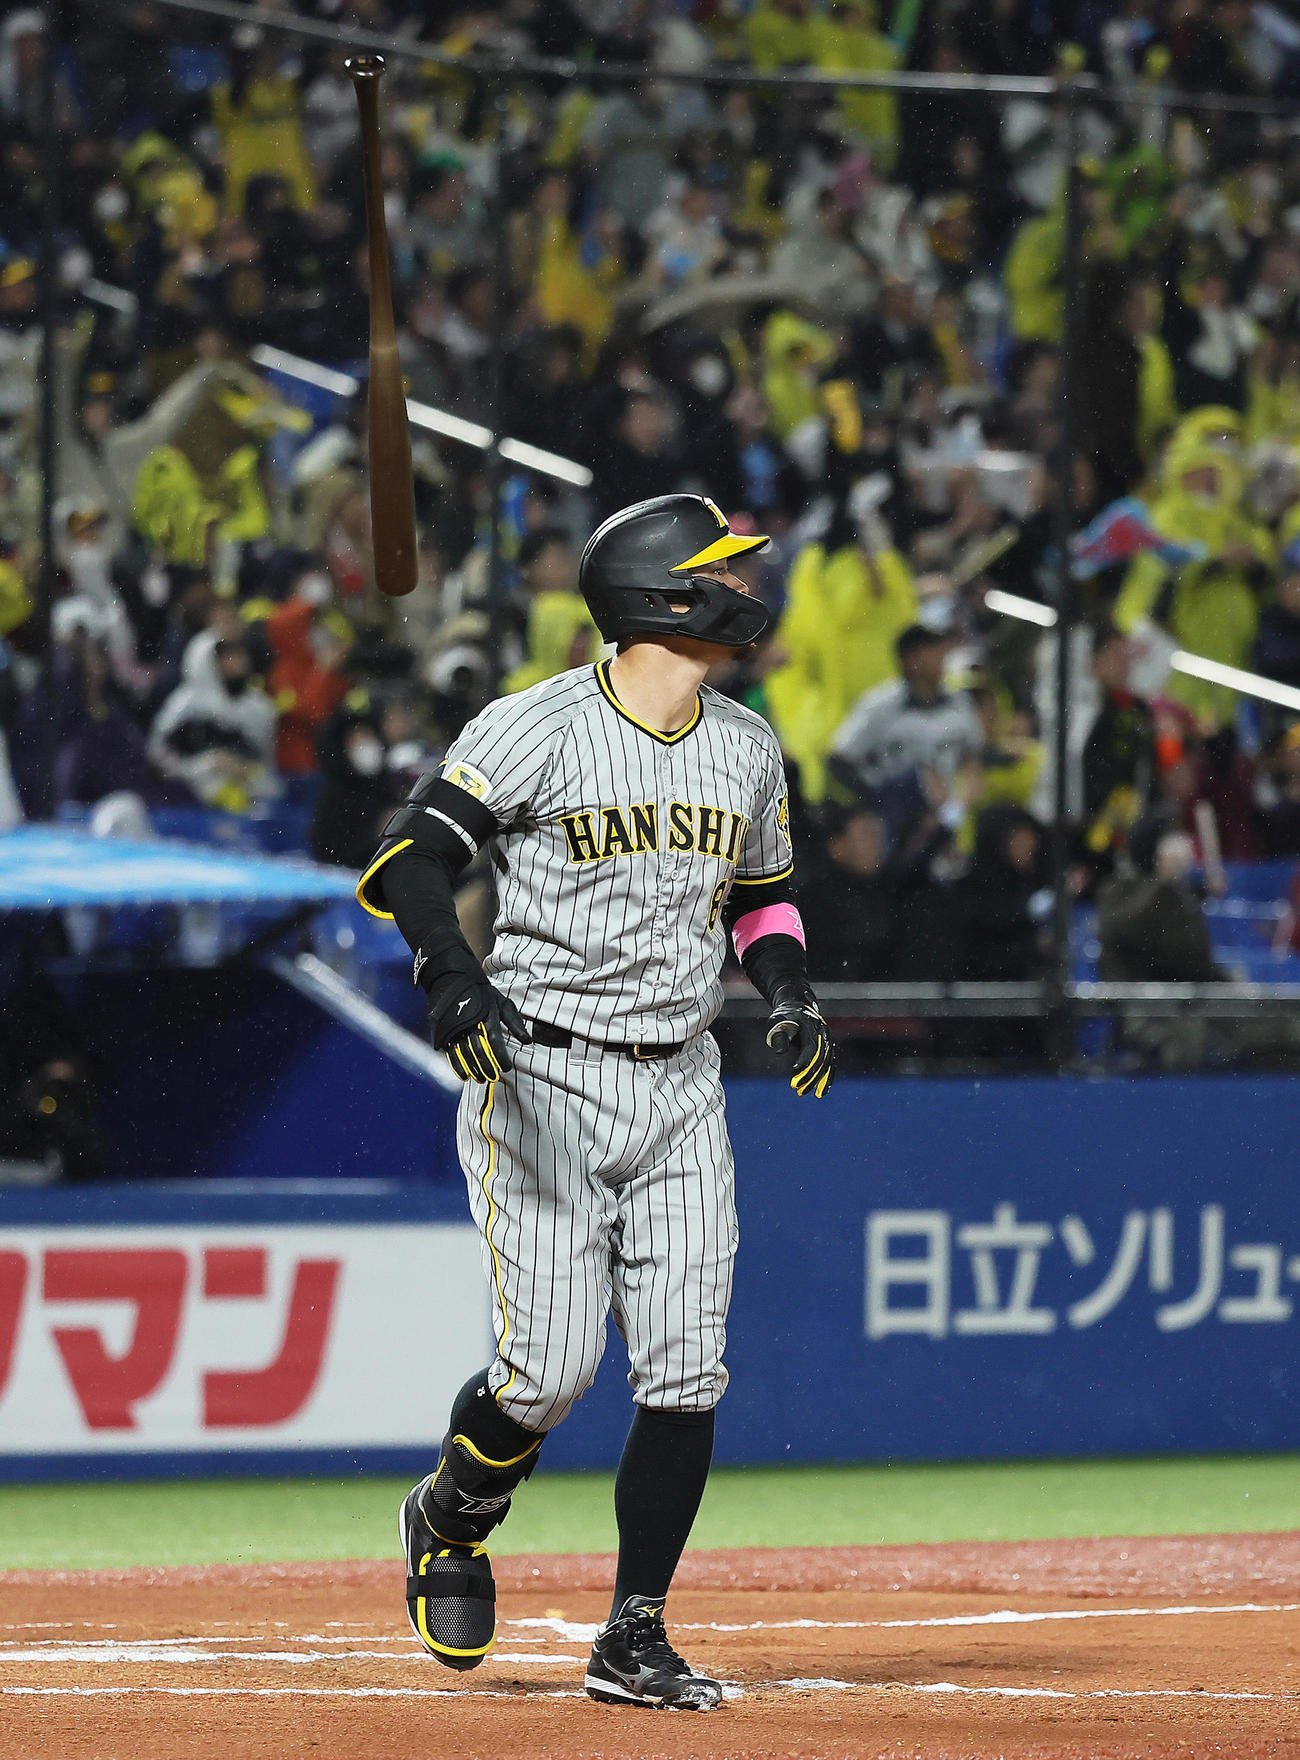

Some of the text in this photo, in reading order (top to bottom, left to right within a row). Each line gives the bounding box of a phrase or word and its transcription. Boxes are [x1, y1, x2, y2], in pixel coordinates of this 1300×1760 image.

[559, 802, 749, 867] HANSHI
[0, 1247, 340, 1431] マン
[866, 1204, 1300, 1340] 日立ソリュ
